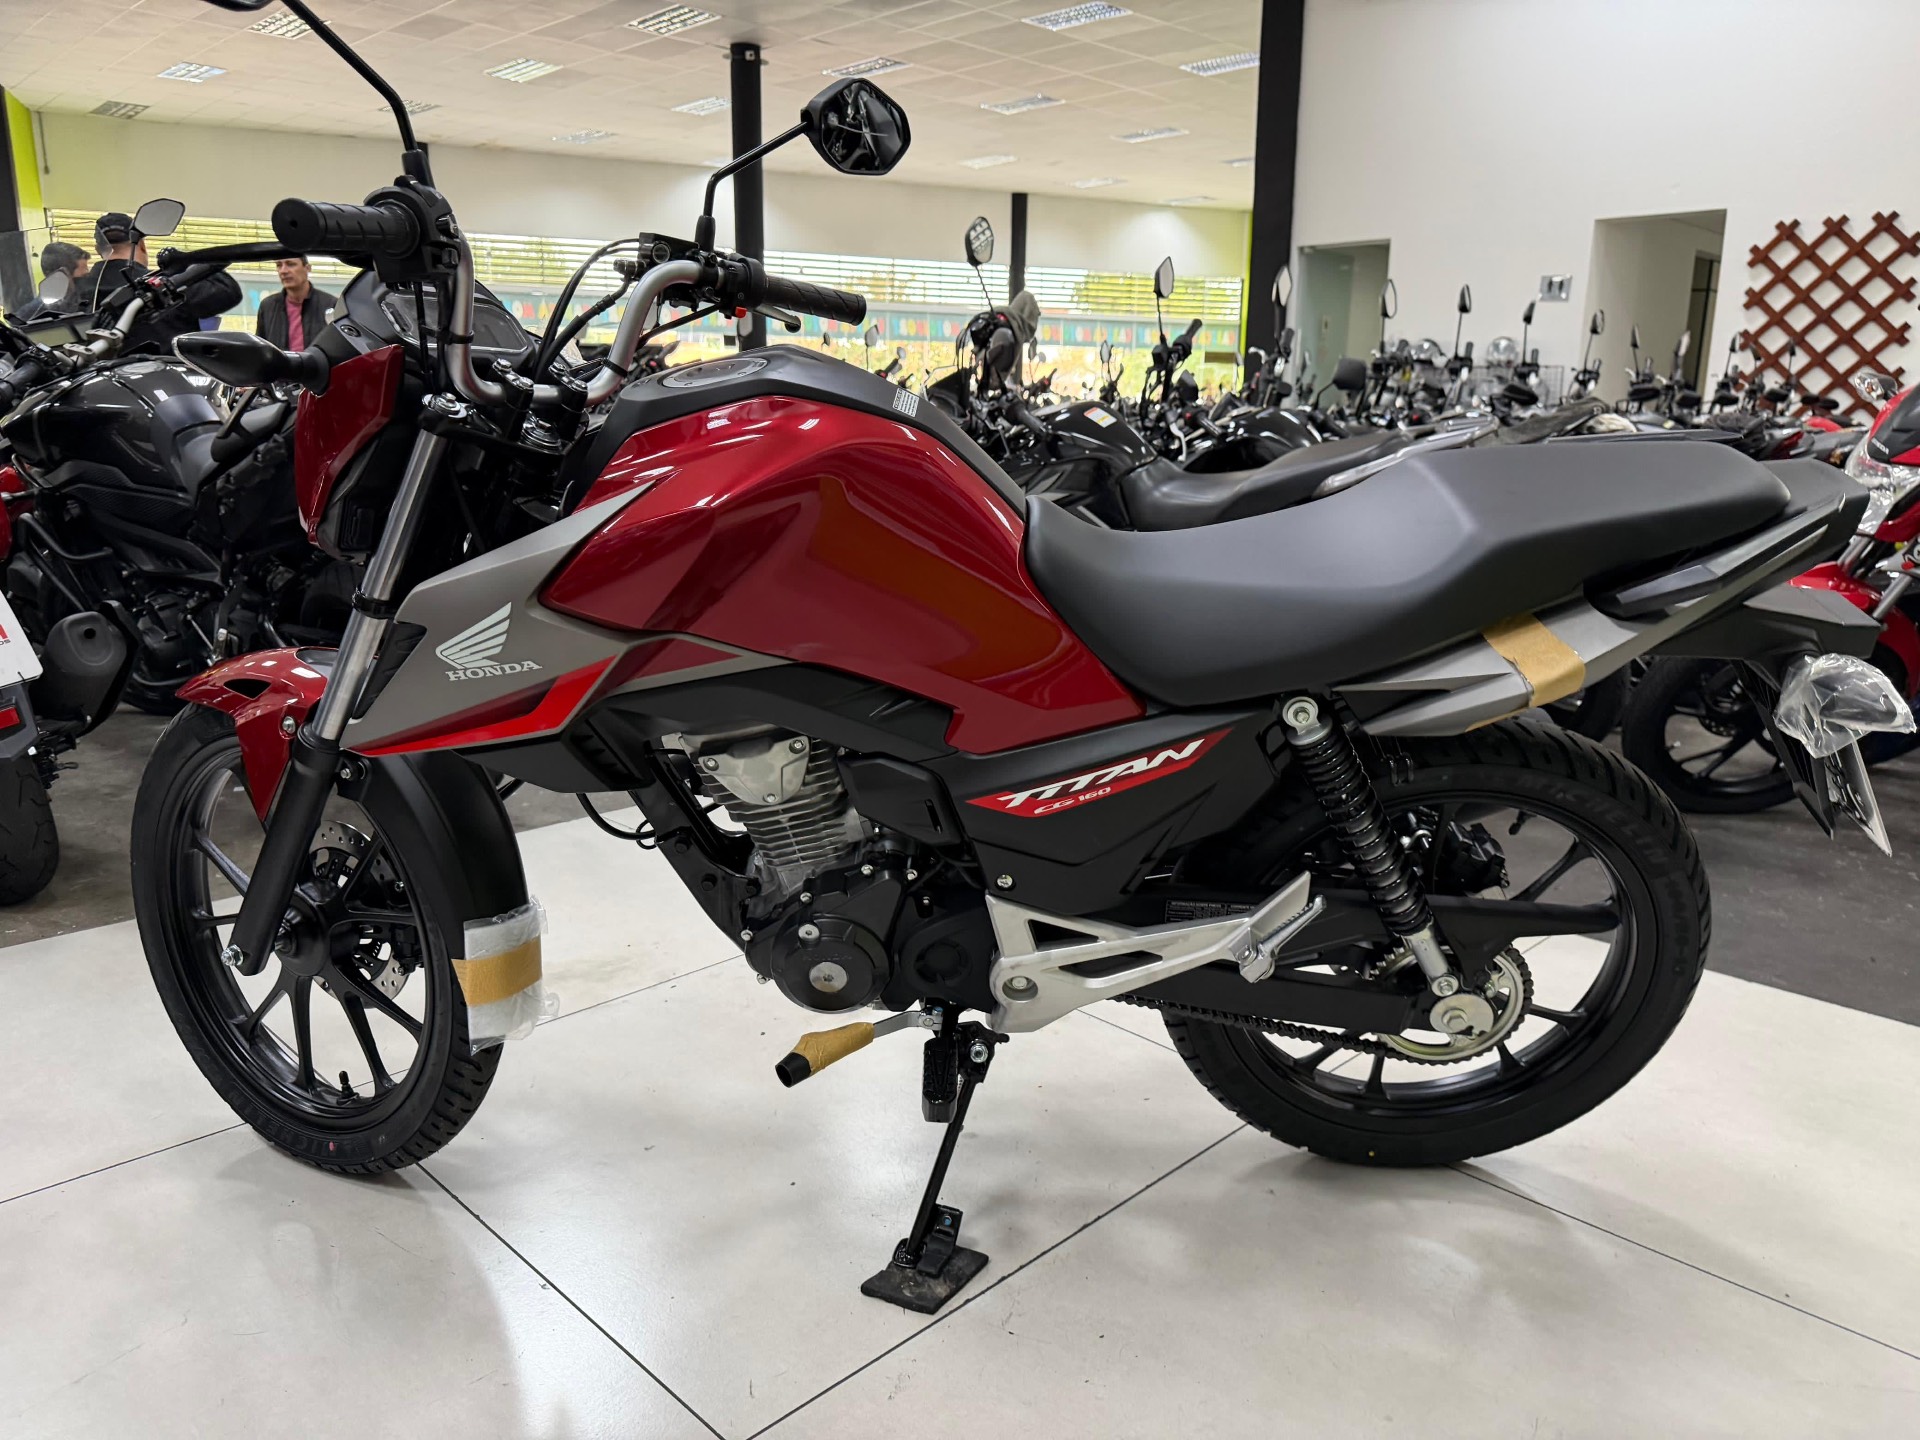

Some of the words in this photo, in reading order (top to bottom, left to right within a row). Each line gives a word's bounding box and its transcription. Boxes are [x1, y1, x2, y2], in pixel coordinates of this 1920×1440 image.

[445, 660, 543, 681] HONDA
[997, 738, 1205, 809] TITAN
[1033, 798, 1075, 814] CG
[1078, 786, 1112, 802] 160
